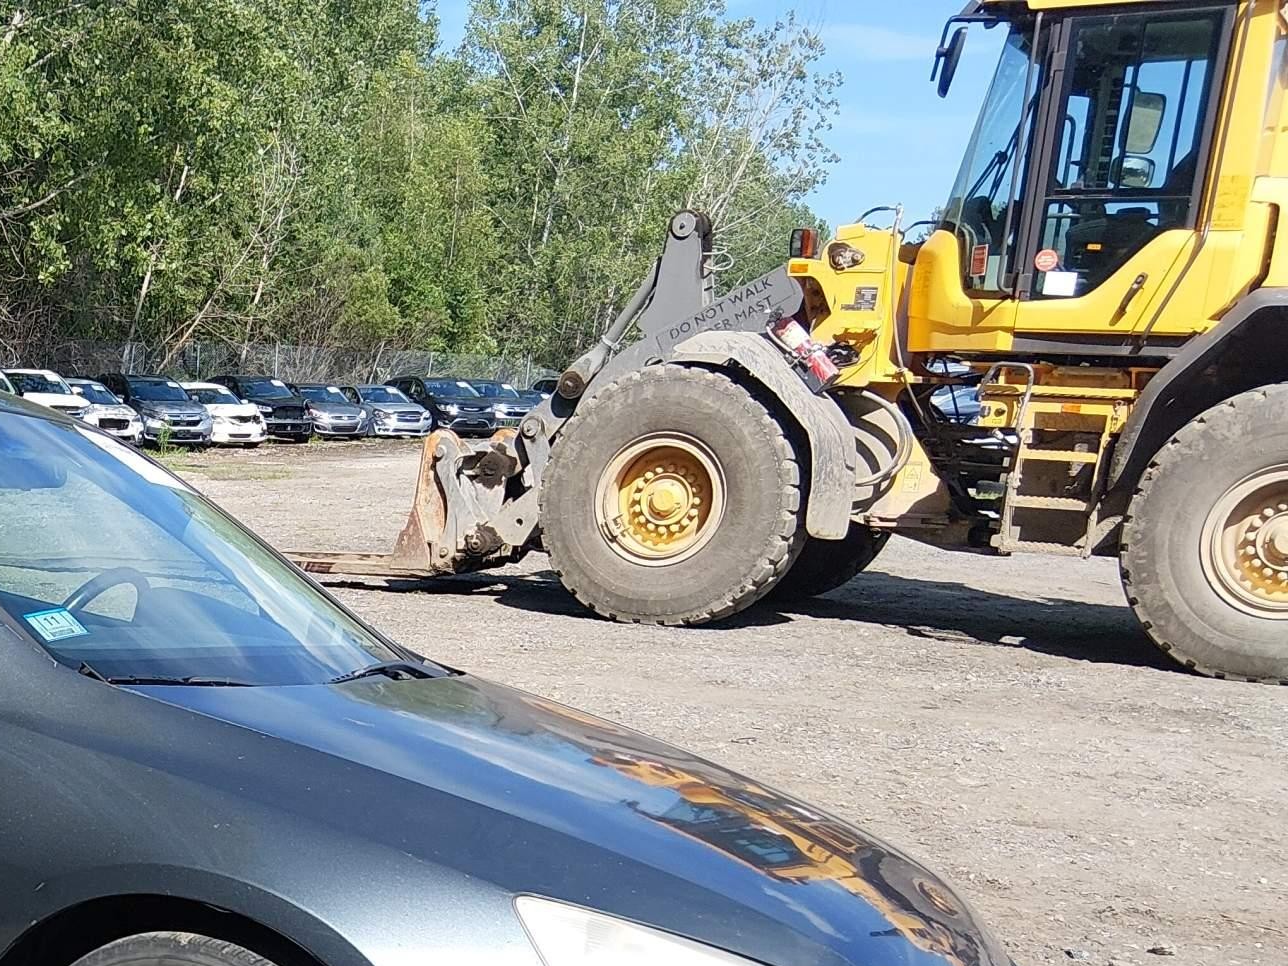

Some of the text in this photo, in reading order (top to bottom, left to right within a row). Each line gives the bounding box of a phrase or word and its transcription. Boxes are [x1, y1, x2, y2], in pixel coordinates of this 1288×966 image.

[669, 278, 773, 340] DO NOT WALK
[735, 294, 772, 321] MAST
[43, 615, 61, 626] 11
